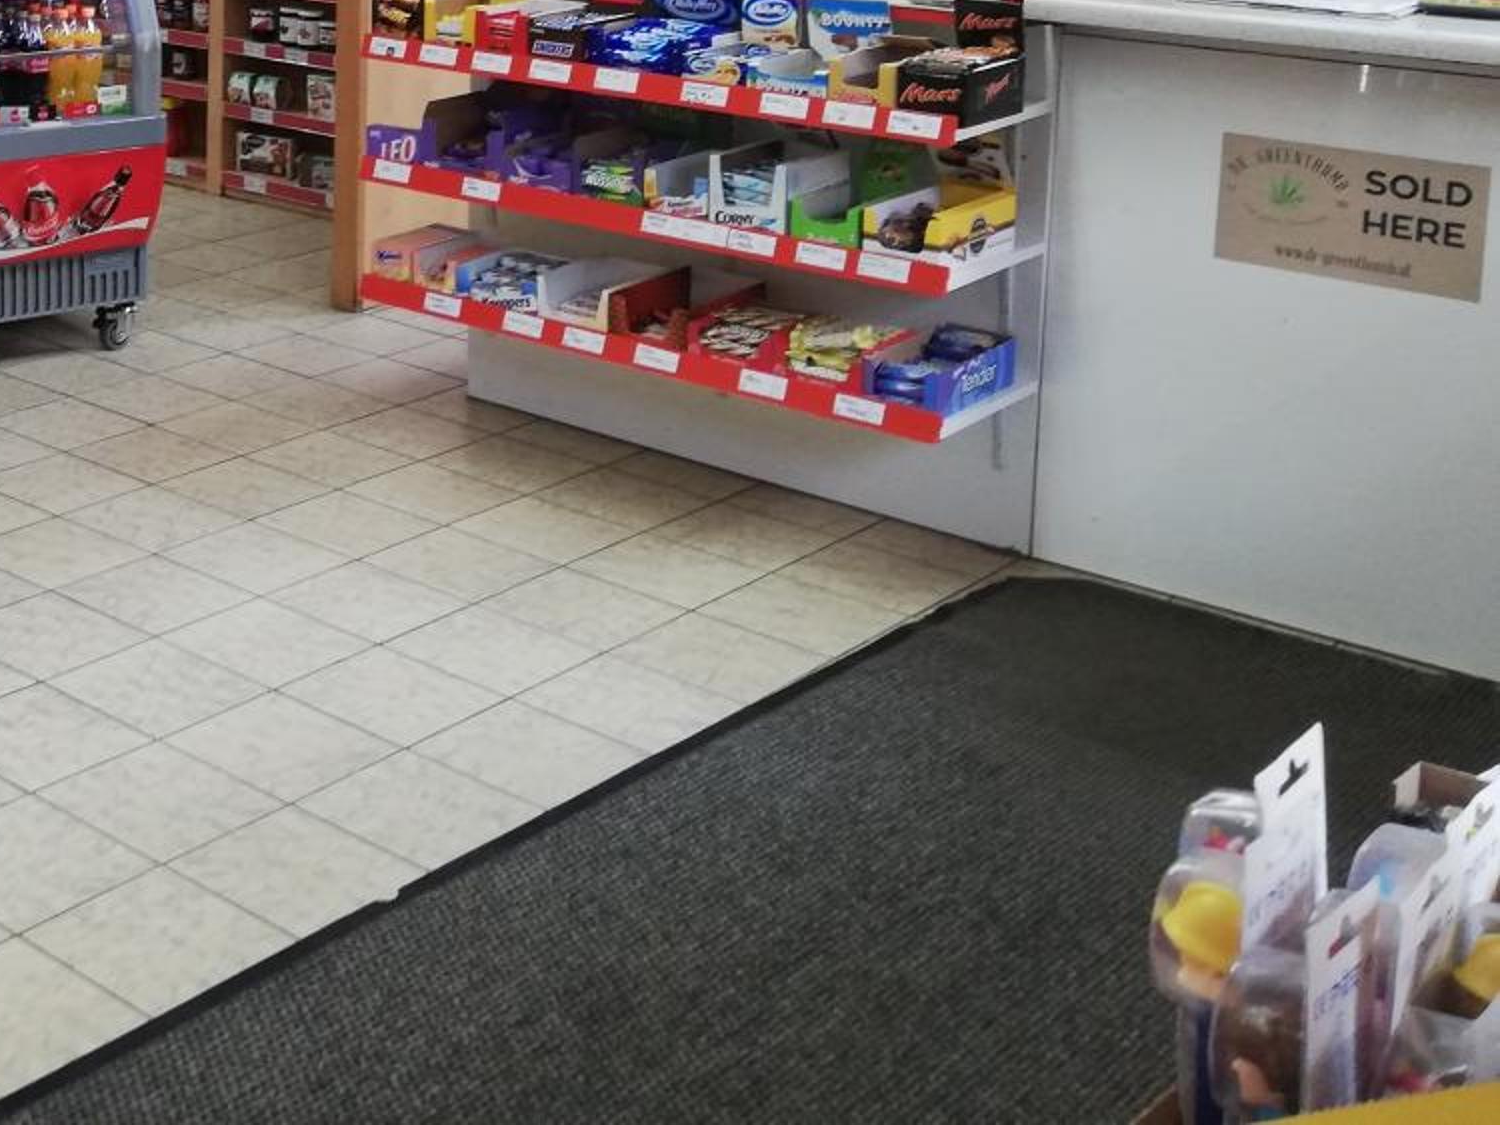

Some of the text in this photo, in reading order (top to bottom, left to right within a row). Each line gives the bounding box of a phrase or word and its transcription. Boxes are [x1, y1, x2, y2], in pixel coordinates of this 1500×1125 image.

[820, 10, 886, 28] BOUNTY
[959, 12, 1018, 31] Mars
[901, 82, 963, 105] Mars
[1363, 170, 1474, 209] SOLD
[1361, 209, 1467, 249] HERE
